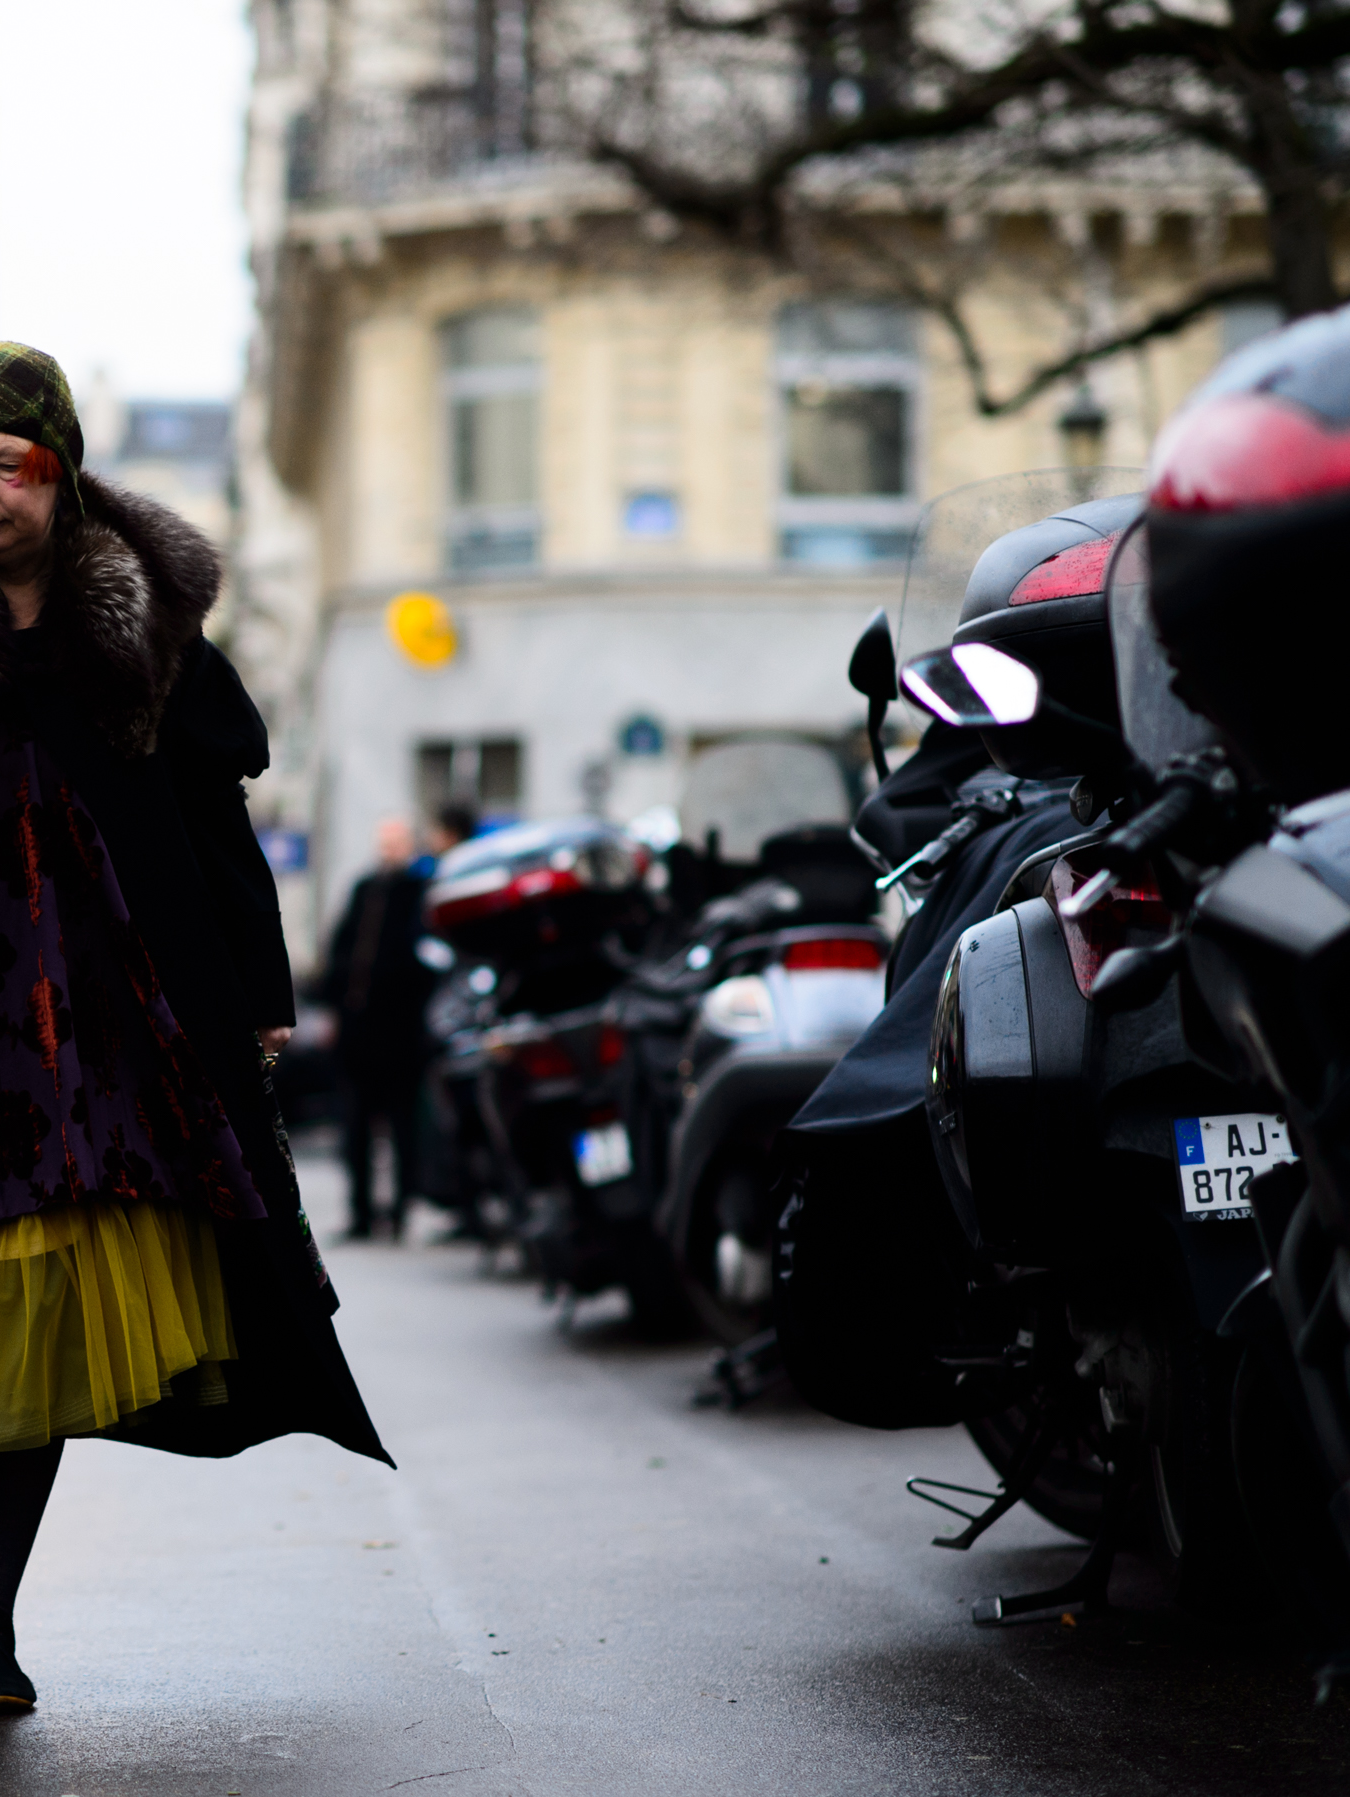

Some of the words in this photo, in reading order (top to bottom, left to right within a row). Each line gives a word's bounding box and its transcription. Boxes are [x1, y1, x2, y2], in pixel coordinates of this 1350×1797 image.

[1186, 1146, 1195, 1157] F
[1193, 1165, 1255, 1204] 872
[1216, 1208, 1255, 1221] JAP
